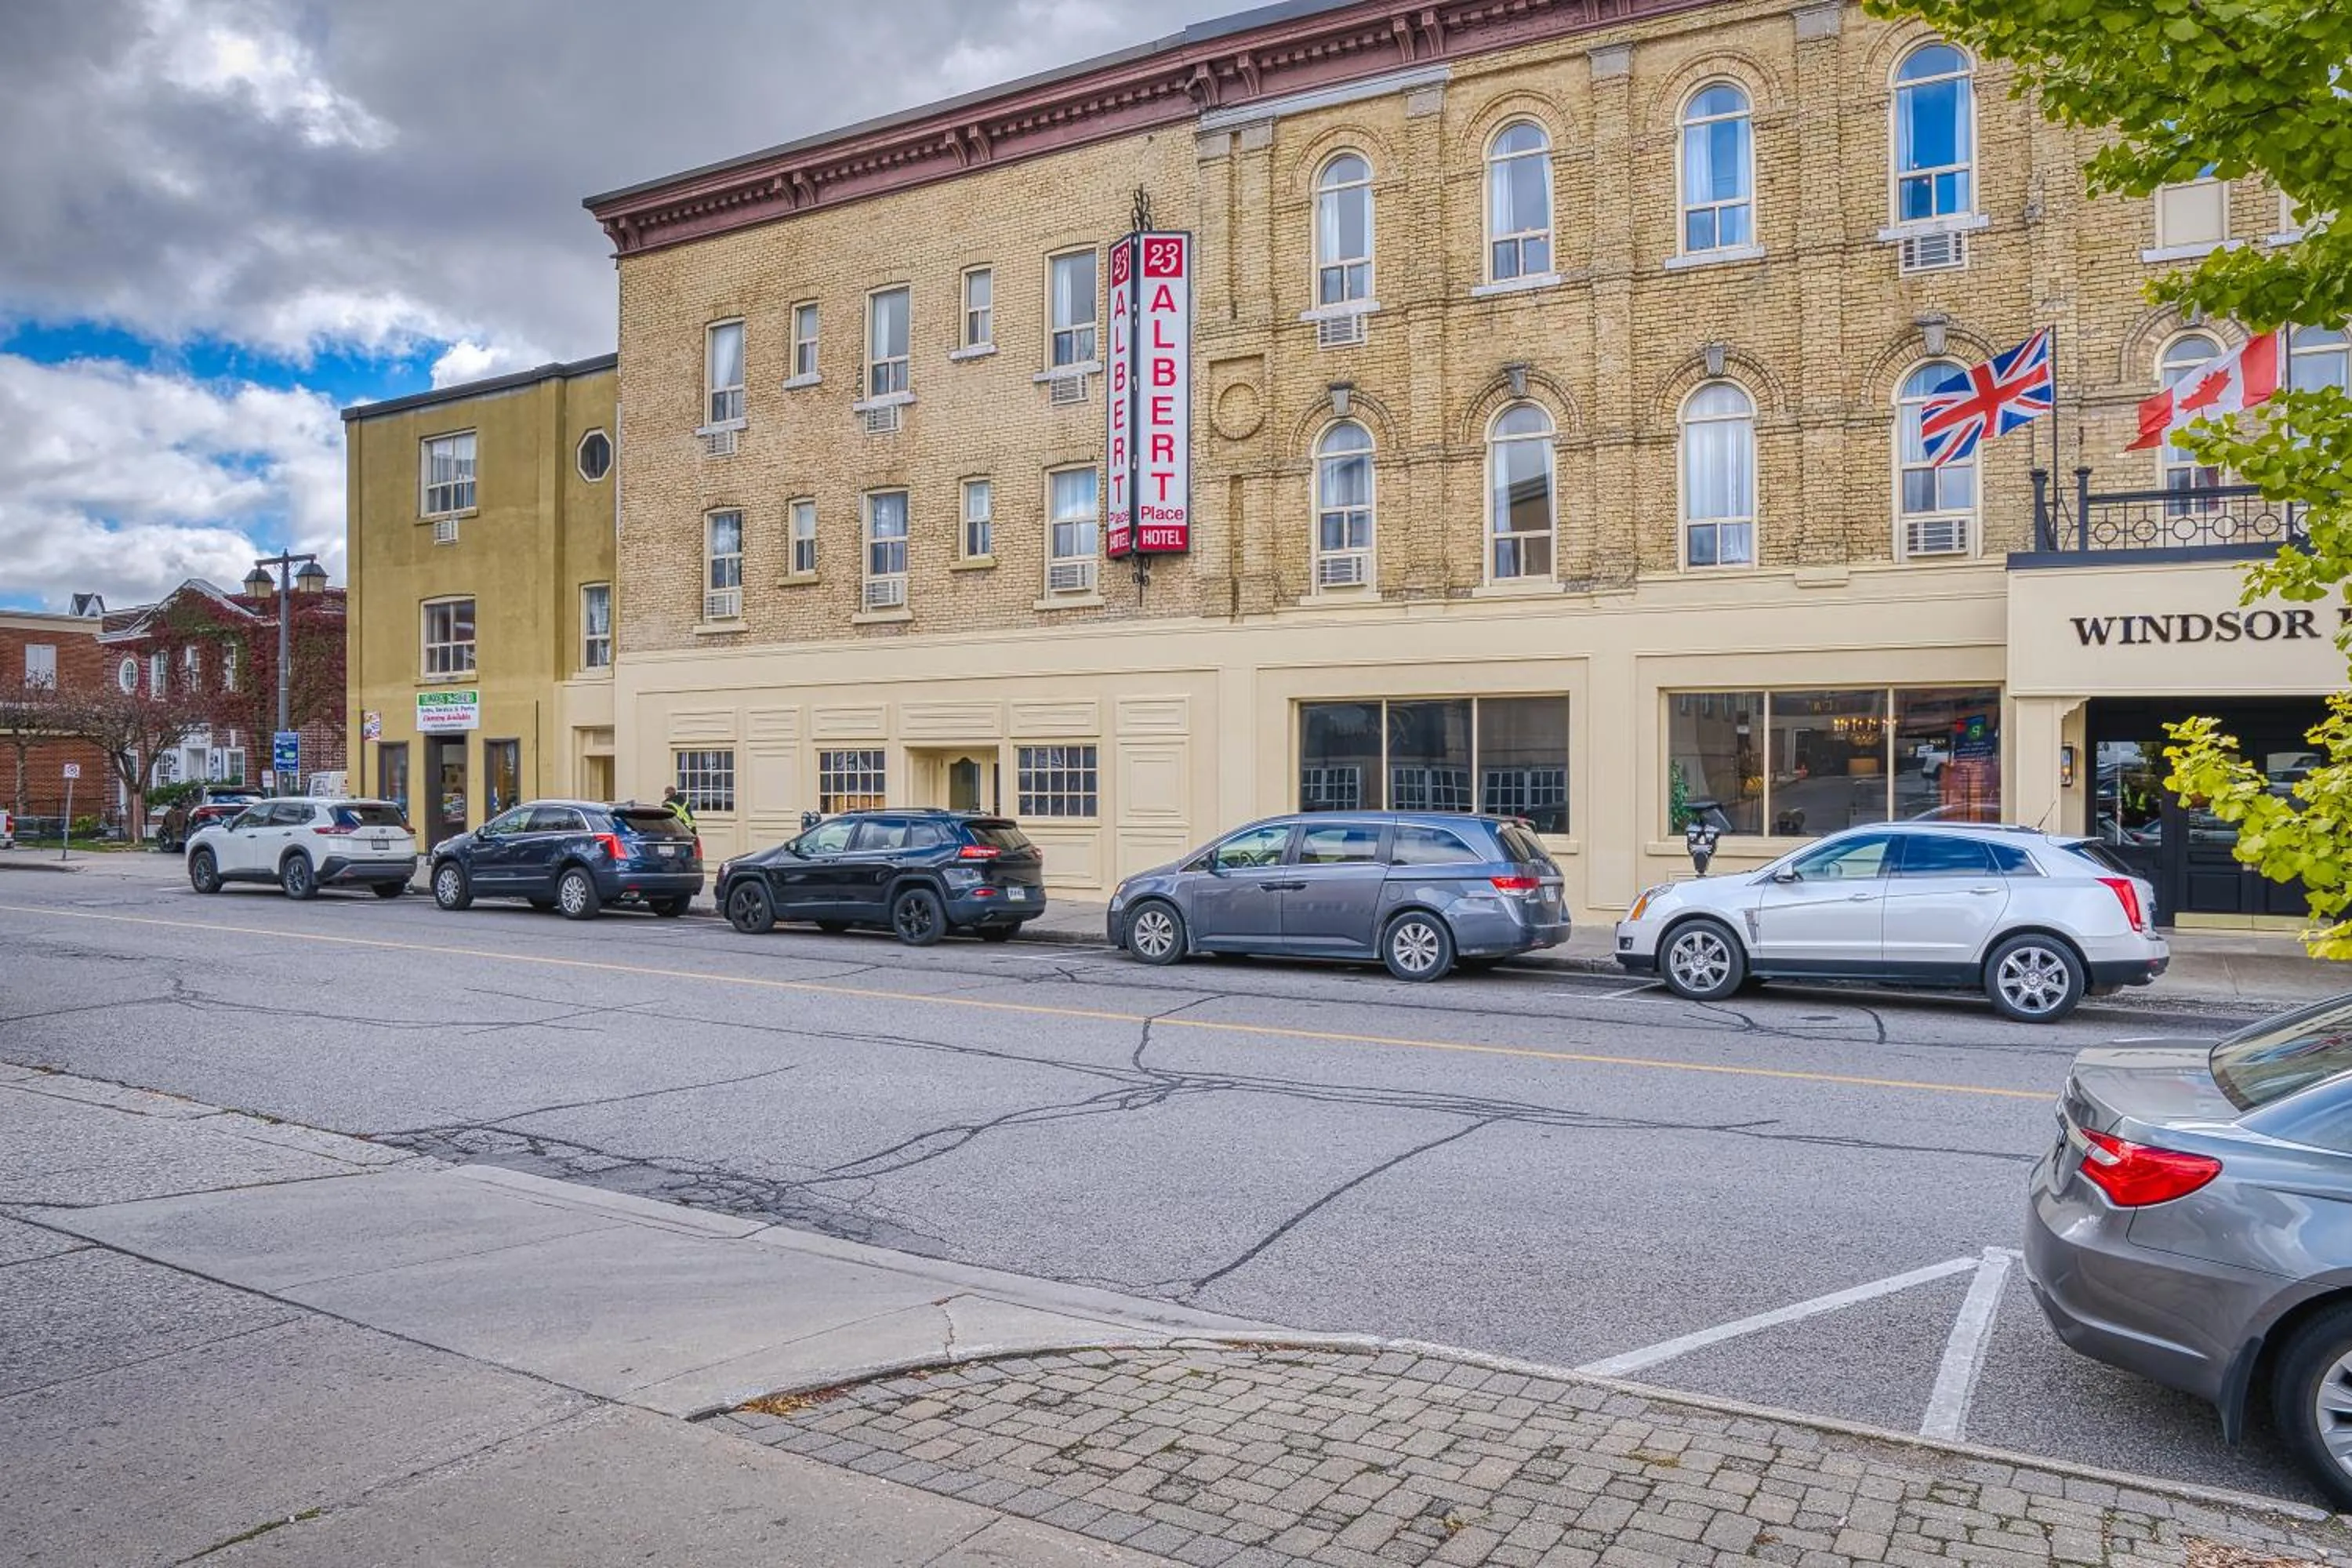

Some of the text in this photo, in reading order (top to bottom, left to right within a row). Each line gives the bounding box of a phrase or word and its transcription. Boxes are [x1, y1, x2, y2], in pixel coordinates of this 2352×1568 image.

[1114, 247, 1128, 280] 23
[1149, 243, 1179, 274] 23
[1113, 289, 1127, 504] ALBERT
[1149, 284, 1178, 502] ALBERT
[1141, 506, 1184, 521] Place
[1109, 532, 1130, 551] HOTEL
[1142, 529, 1183, 546] HOTEL
[2070, 608, 2321, 646] WINDSOR
